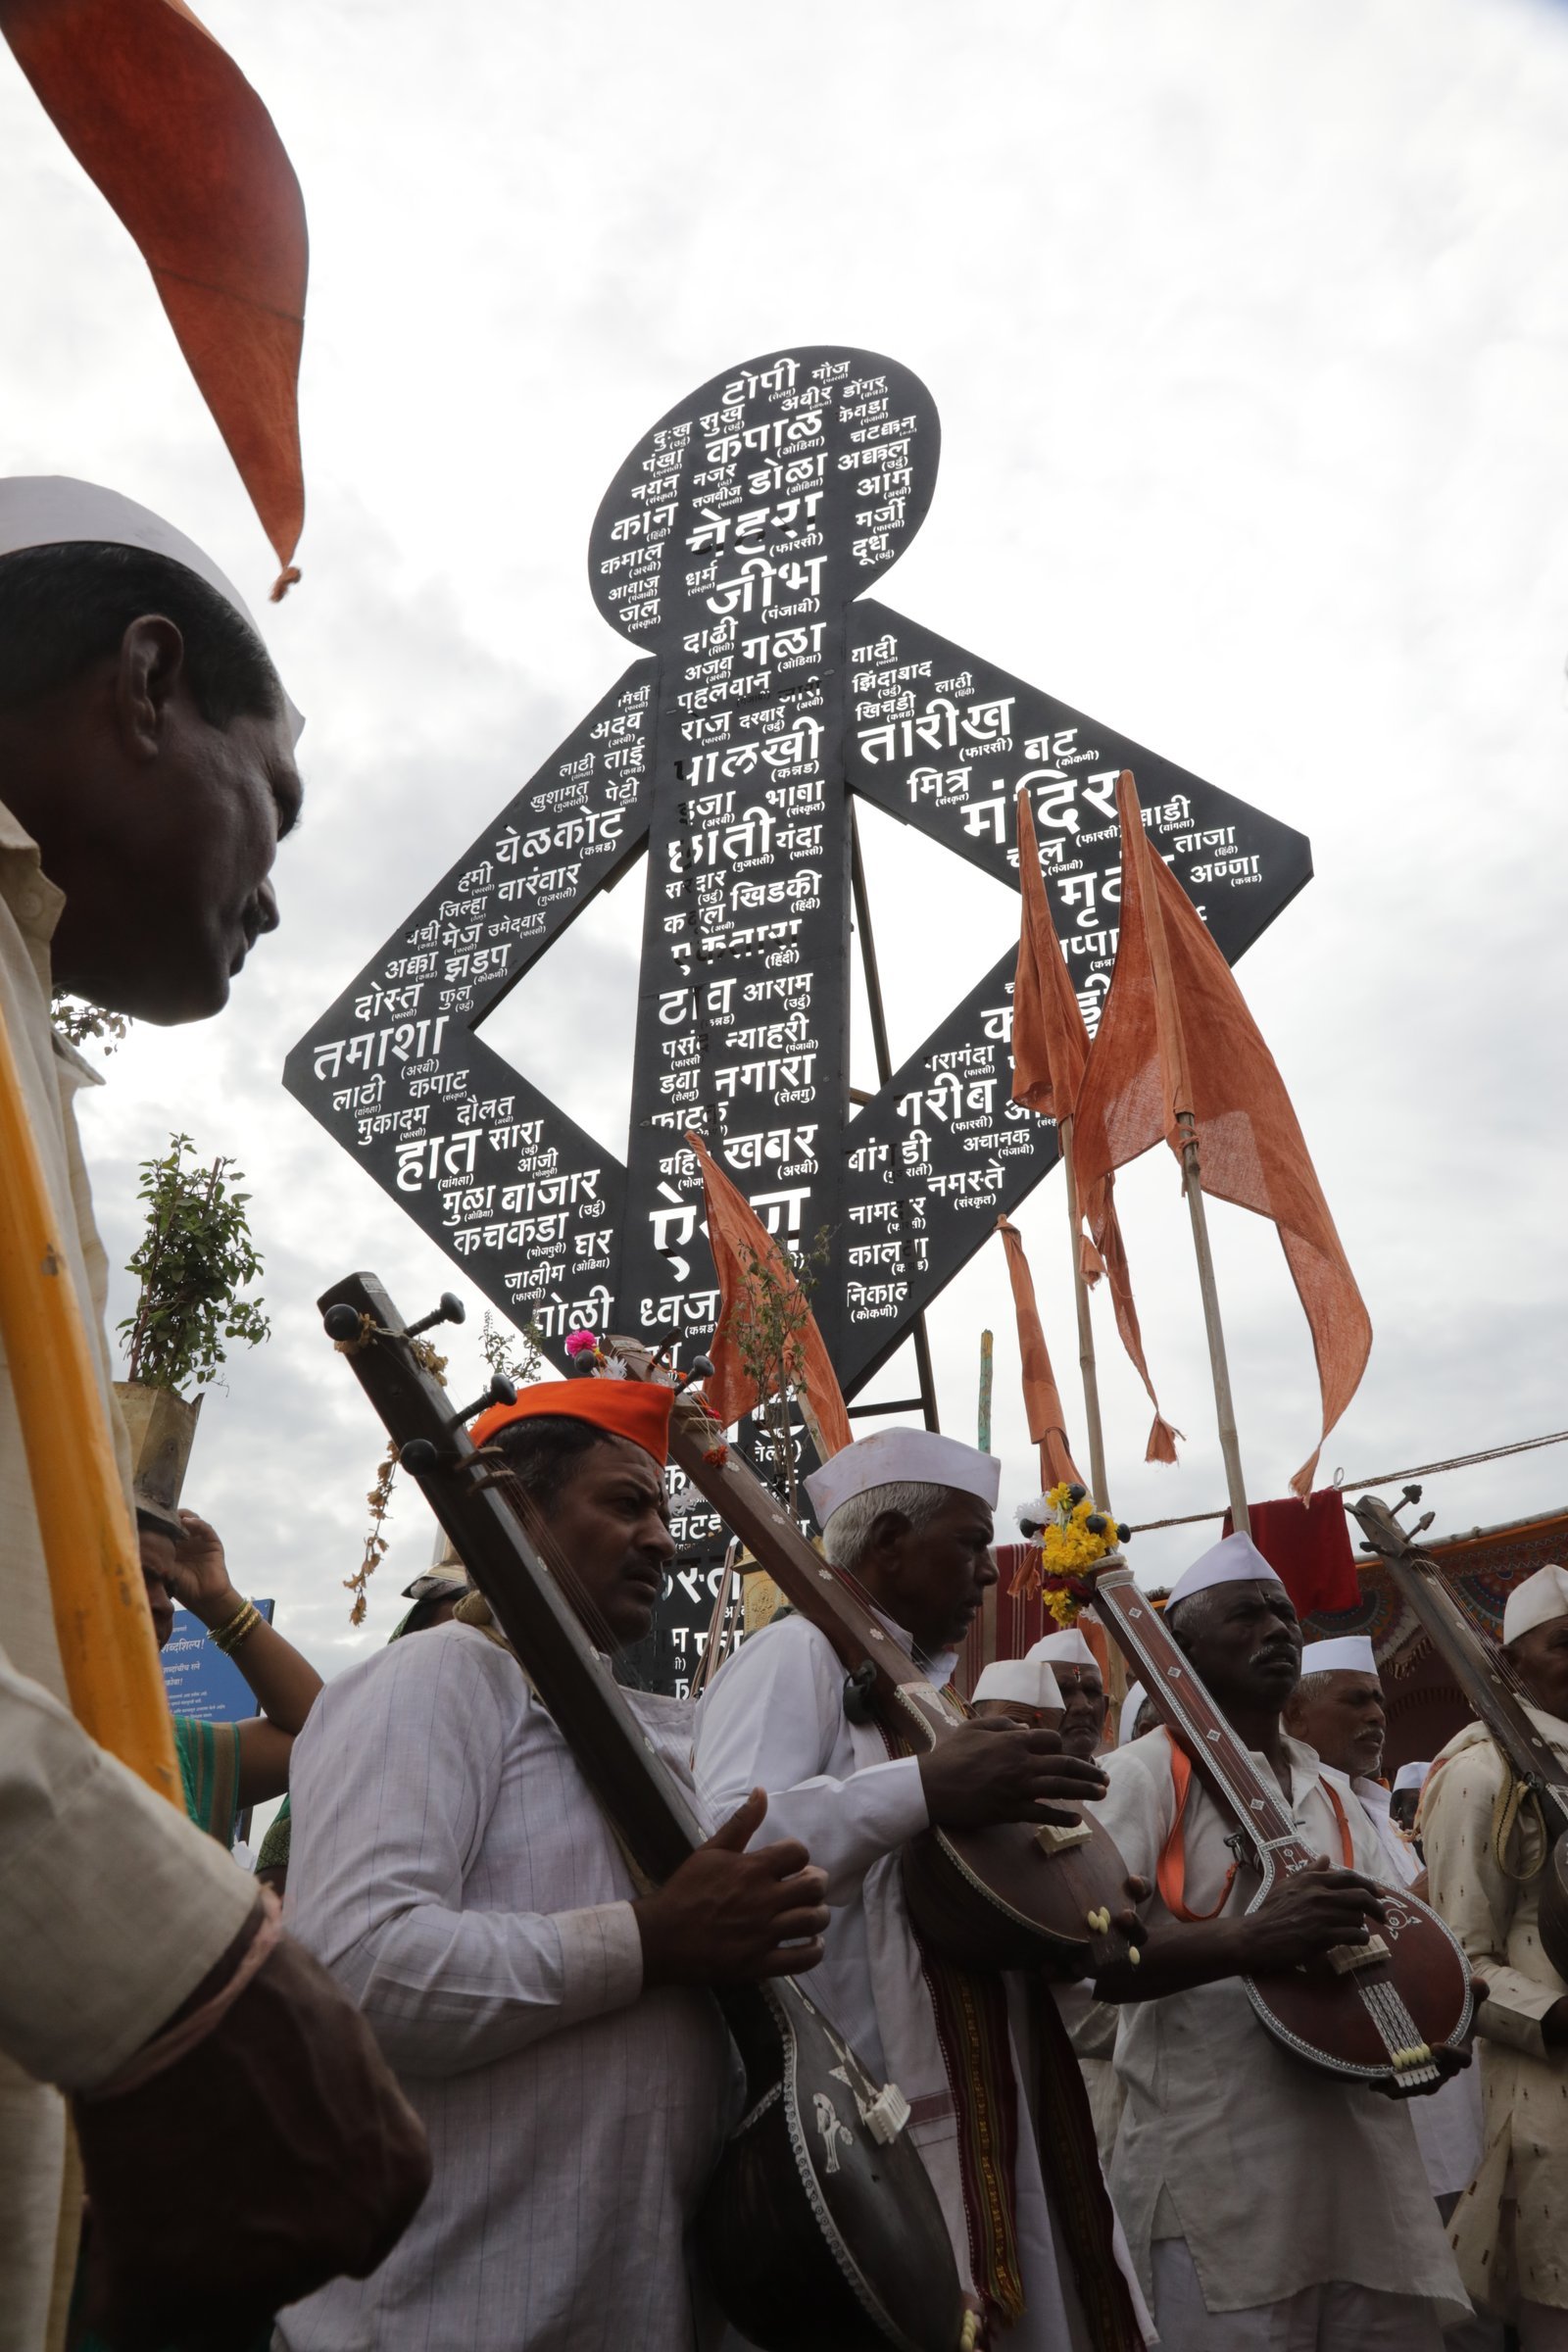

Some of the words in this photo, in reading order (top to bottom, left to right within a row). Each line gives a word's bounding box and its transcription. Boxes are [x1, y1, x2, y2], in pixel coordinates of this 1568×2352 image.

[722, 358, 801, 405] टोपी
[811, 361, 851, 382] मौज
[840, 373, 888, 400] डोंगर
[700, 404, 745, 437] सुख
[706, 409, 824, 466] कपाळ
[642, 449, 684, 475] पंखा
[838, 438, 910, 471] अक्कल
[693, 463, 737, 488] नजर
[748, 452, 828, 496] डोळा
[692, 485, 743, 509] तजवीज
[856, 496, 906, 527] मर्जी
[611, 502, 679, 542] कान
[685, 491, 824, 558] चेहरा
[601, 542, 664, 575] कमाल
[853, 533, 891, 565] दूध
[609, 575, 661, 604] आवाज
[685, 560, 717, 588] धर्म
[706, 556, 828, 615] जीभ
[619, 597, 661, 623] जल
[683, 615, 739, 657] दाढी
[742, 622, 826, 667] गळा
[855, 689, 916, 722] खिचडी
[855, 697, 1015, 764] तारीख
[604, 737, 645, 772] ताई
[673, 715, 825, 787] पालखी
[959, 737, 1012, 761] (फारसी)
[605, 777, 640, 803] पेटी
[906, 766, 972, 805] मित्र
[960, 768, 1120, 846] मंदिर
[495, 805, 626, 865] येळकोट
[1173, 826, 1238, 856] ताजा
[498, 863, 581, 901] वारंवार
[1190, 855, 1262, 885] अण्णा
[729, 869, 823, 912] खिडकी
[439, 896, 488, 922] जिल्हा
[488, 911, 546, 939] उमेदवार
[442, 922, 483, 949] मेज
[385, 952, 439, 982] अक्का
[355, 981, 424, 1022] दोस्त
[743, 972, 813, 1002] आराम
[314, 1014, 450, 1081] तमाशा
[410, 1069, 469, 1101] कपाट
[714, 1054, 816, 1098] नगारा
[457, 1092, 515, 1126] दौलत
[893, 1072, 998, 1127] गरीब
[358, 1103, 430, 1146] मुकादम
[488, 1118, 544, 1153] सारा
[963, 1129, 1030, 1153] अचानक
[395, 1127, 482, 1192] हात
[517, 1145, 559, 1174] आजी
[720, 1124, 818, 1169] खबर
[502, 1167, 601, 1215] बाजार
[927, 1158, 1005, 1199] नमस्ते
[442, 1185, 496, 1226] मुळा
[454, 1209, 569, 1258] कचकडा
[574, 1229, 613, 1257] घर
[505, 1261, 565, 1289] जालीम
